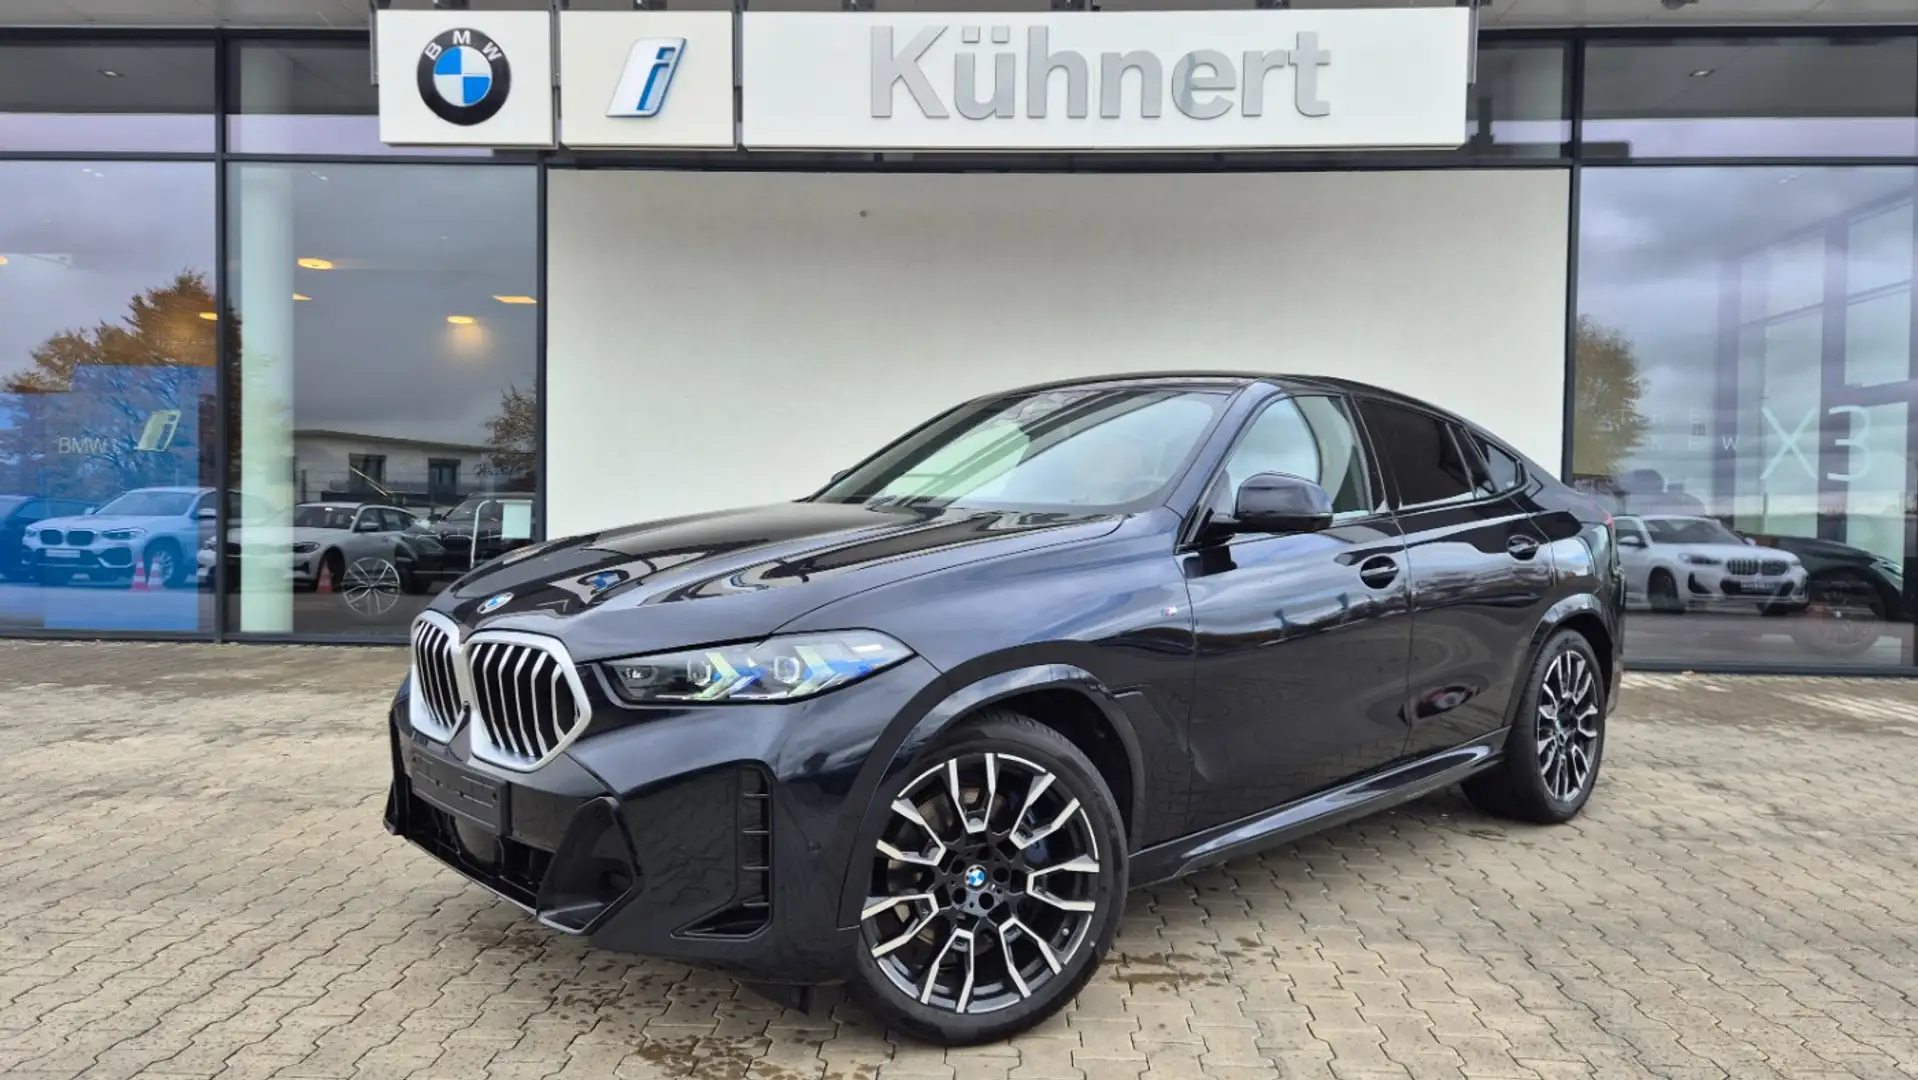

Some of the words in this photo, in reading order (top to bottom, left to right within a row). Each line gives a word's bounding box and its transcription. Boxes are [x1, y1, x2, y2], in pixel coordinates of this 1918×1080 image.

[424, 29, 503, 61] BMW
[870, 25, 1331, 119] Kühnert
[58, 437, 108, 453] BMW
[1760, 405, 1872, 481] X3
